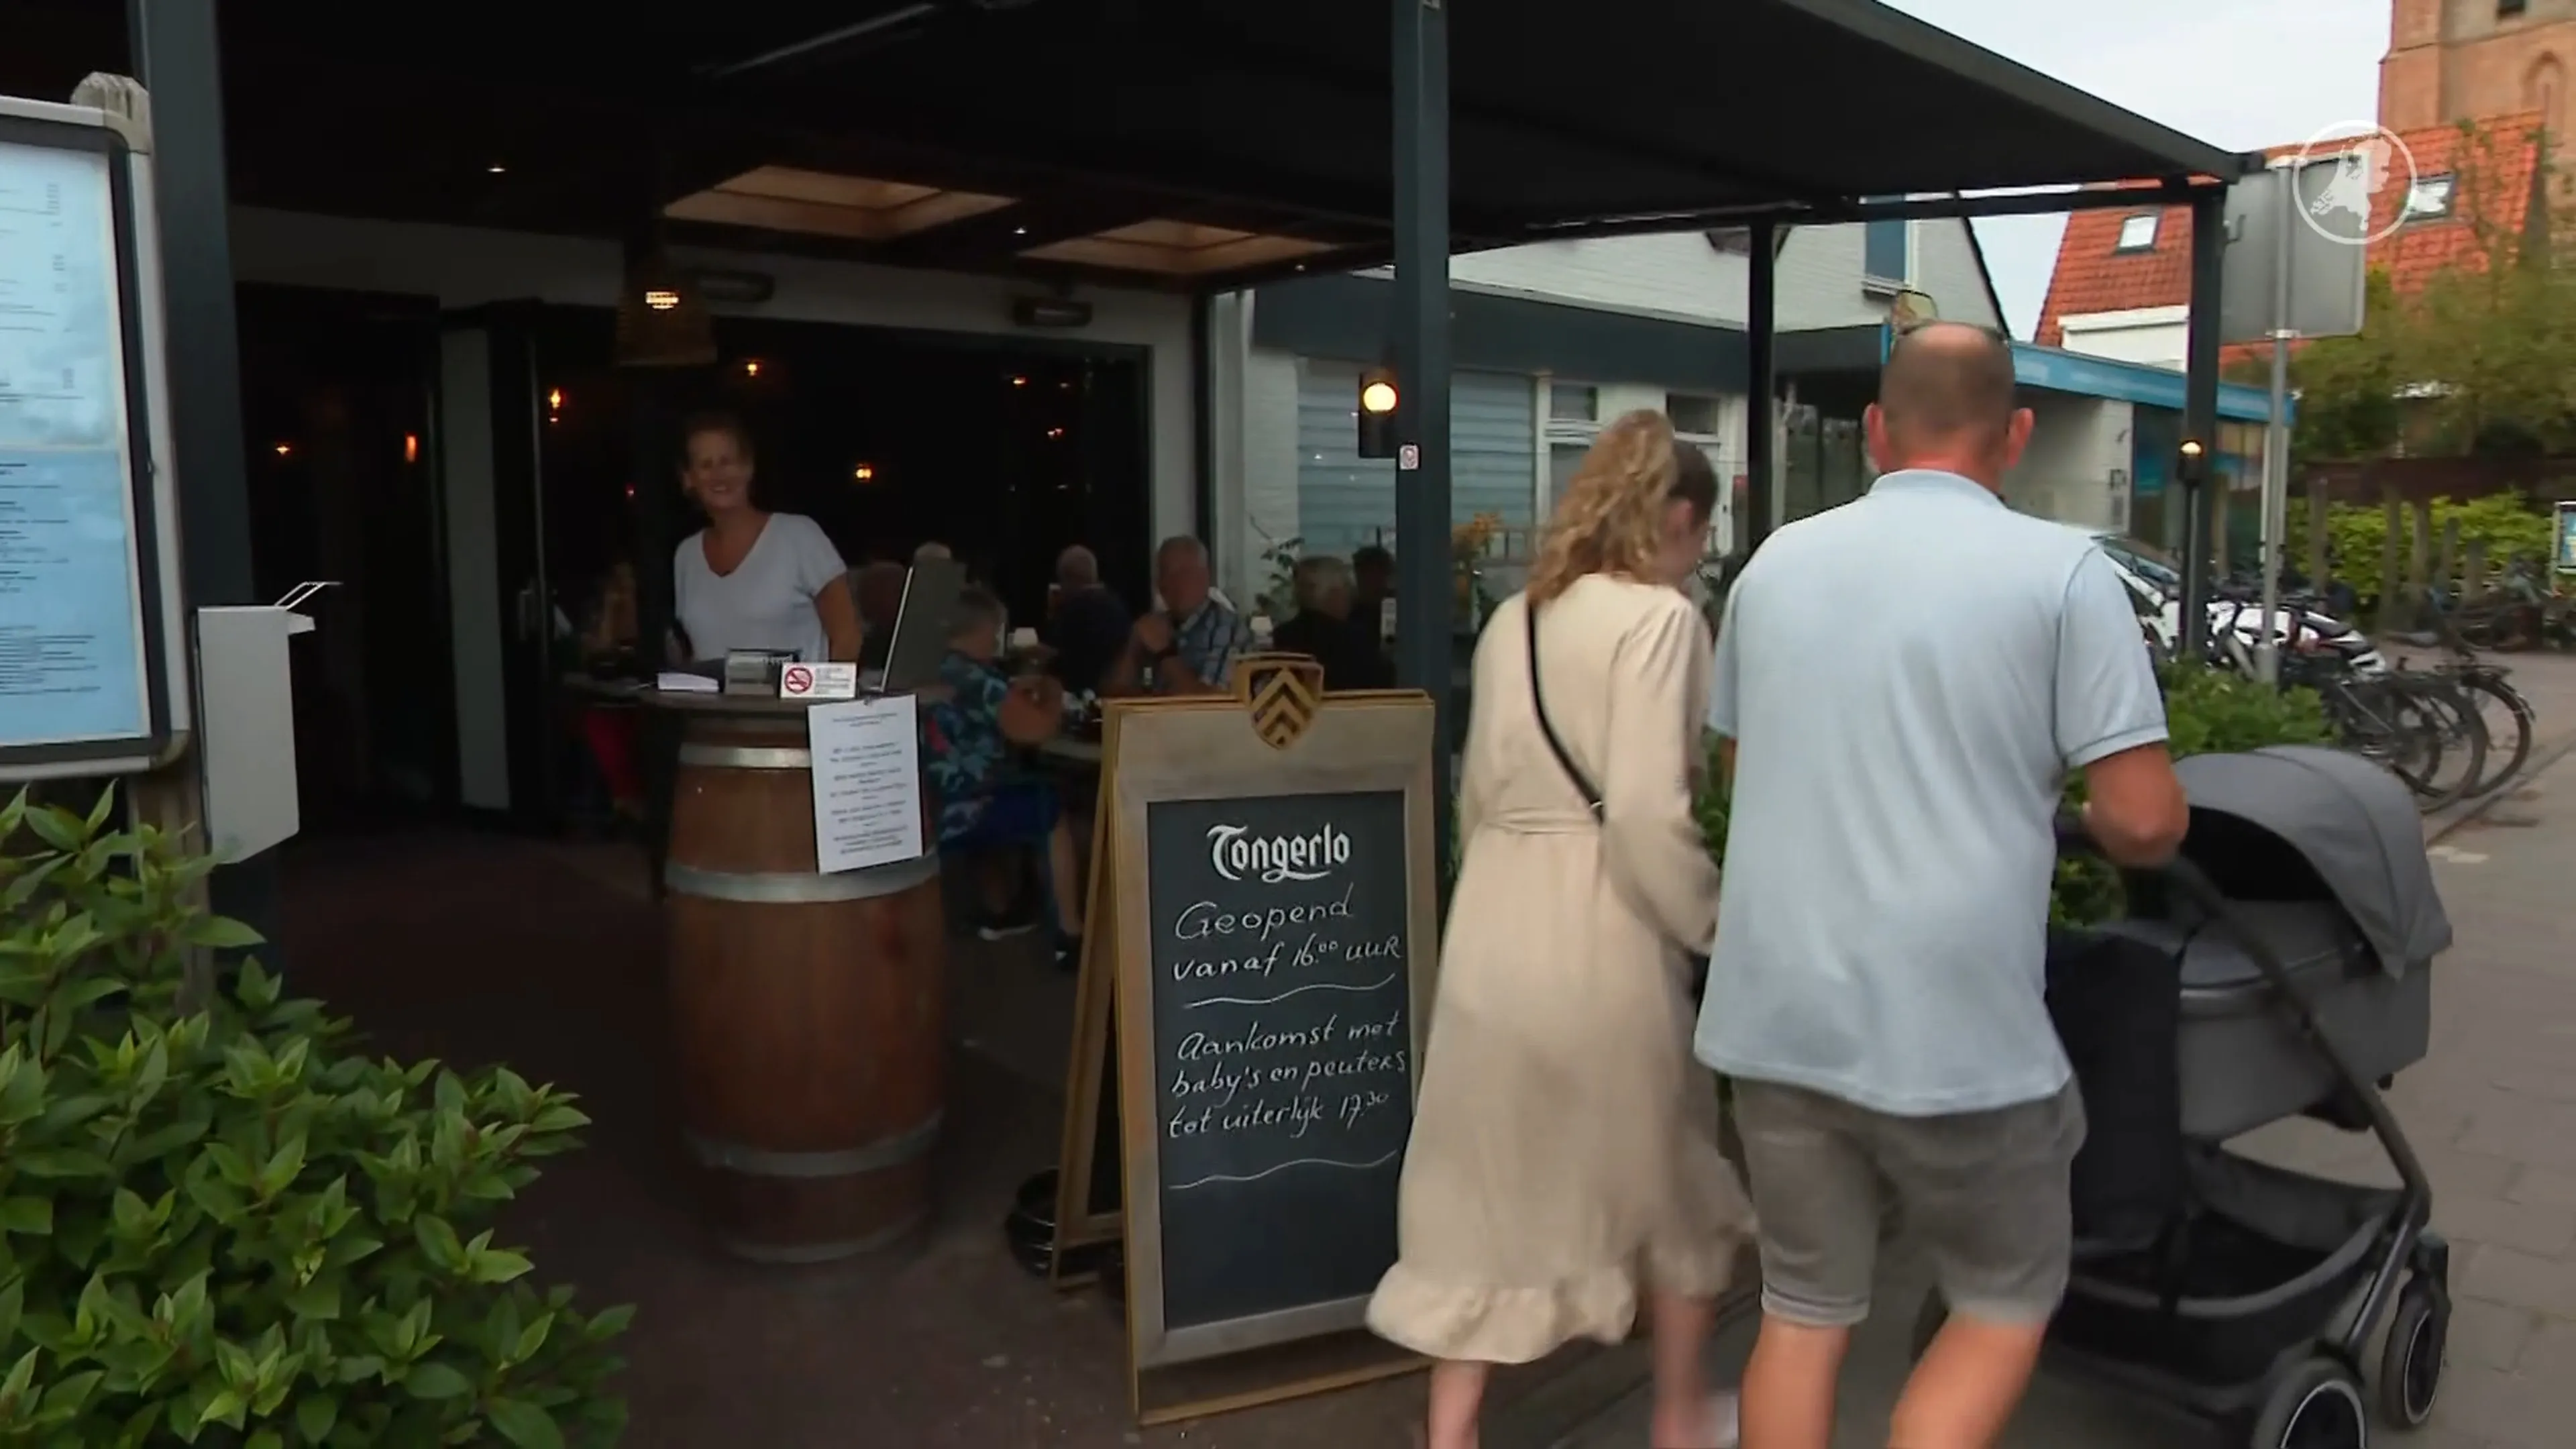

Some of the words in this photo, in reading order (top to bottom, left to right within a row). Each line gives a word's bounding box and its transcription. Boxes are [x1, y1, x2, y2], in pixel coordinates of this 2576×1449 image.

[1207, 822, 1350, 883] Tongerlo
[1175, 883, 1354, 941] Geopend
[1174, 941, 1285, 981] vanaf
[1178, 1014, 1338, 1061] Aankomst
[1348, 1010, 1399, 1040] met
[1172, 1061, 1261, 1108] baby's
[1270, 1067, 1298, 1081] en
[1169, 1106, 1212, 1138] tot
[1223, 1095, 1324, 1138] uiterlijk
